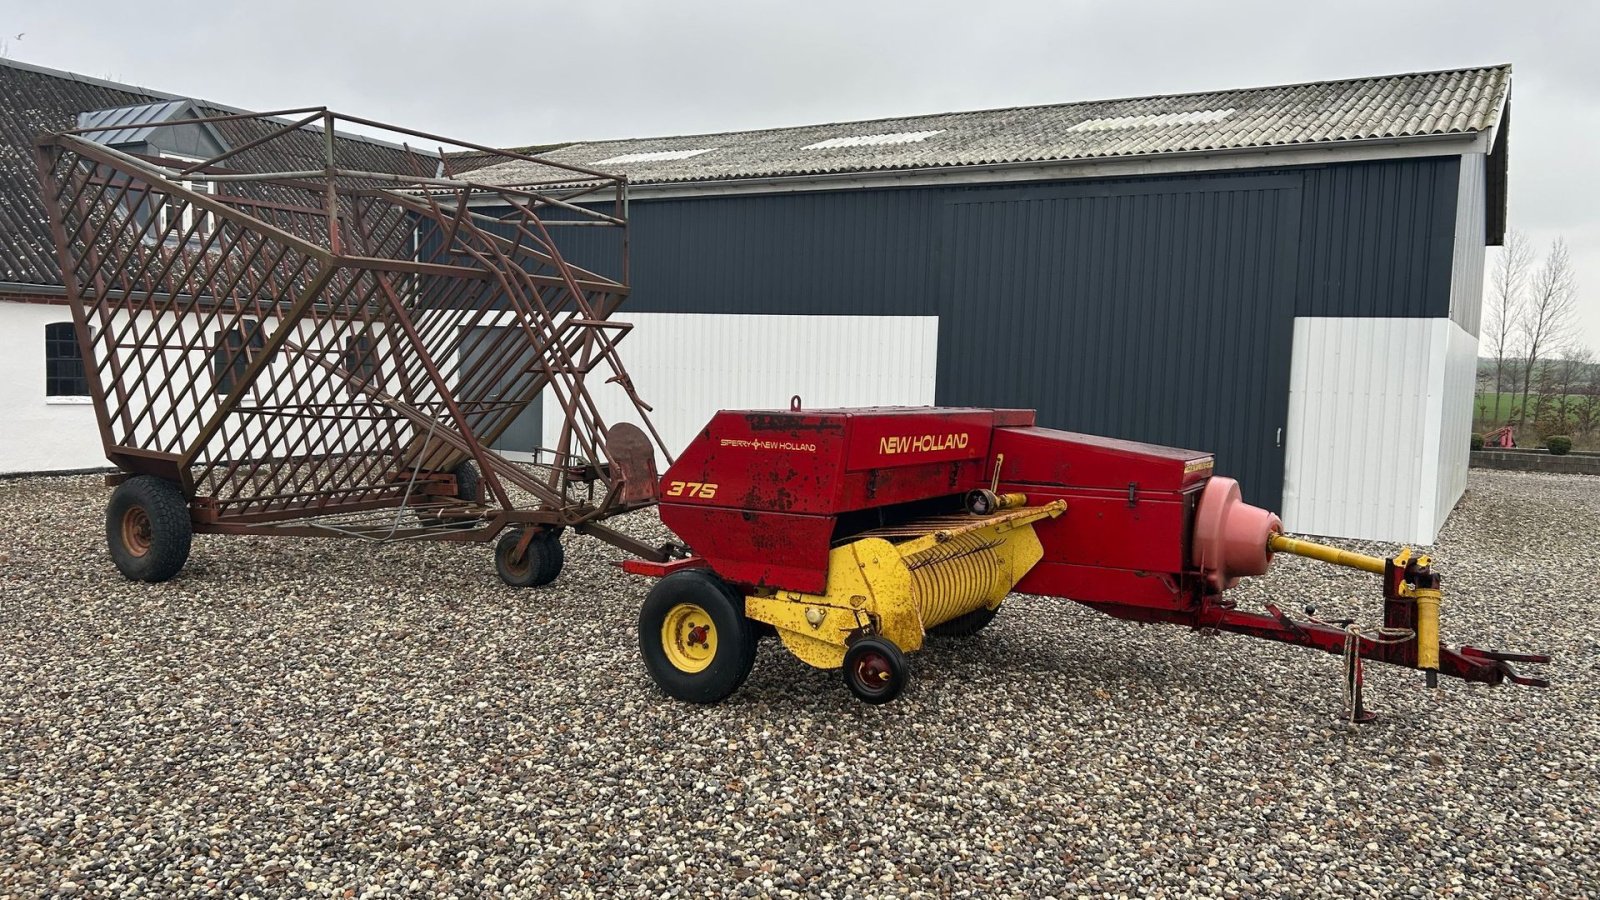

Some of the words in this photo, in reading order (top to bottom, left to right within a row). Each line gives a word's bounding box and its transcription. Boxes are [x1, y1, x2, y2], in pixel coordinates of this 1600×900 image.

[720, 439, 752, 448] SPERRY
[760, 441, 778, 449] NEW
[779, 442, 816, 452] HOLLAND
[879, 436, 912, 455] NEW
[912, 433, 968, 452] HOLLAND
[666, 481, 718, 499] 375
